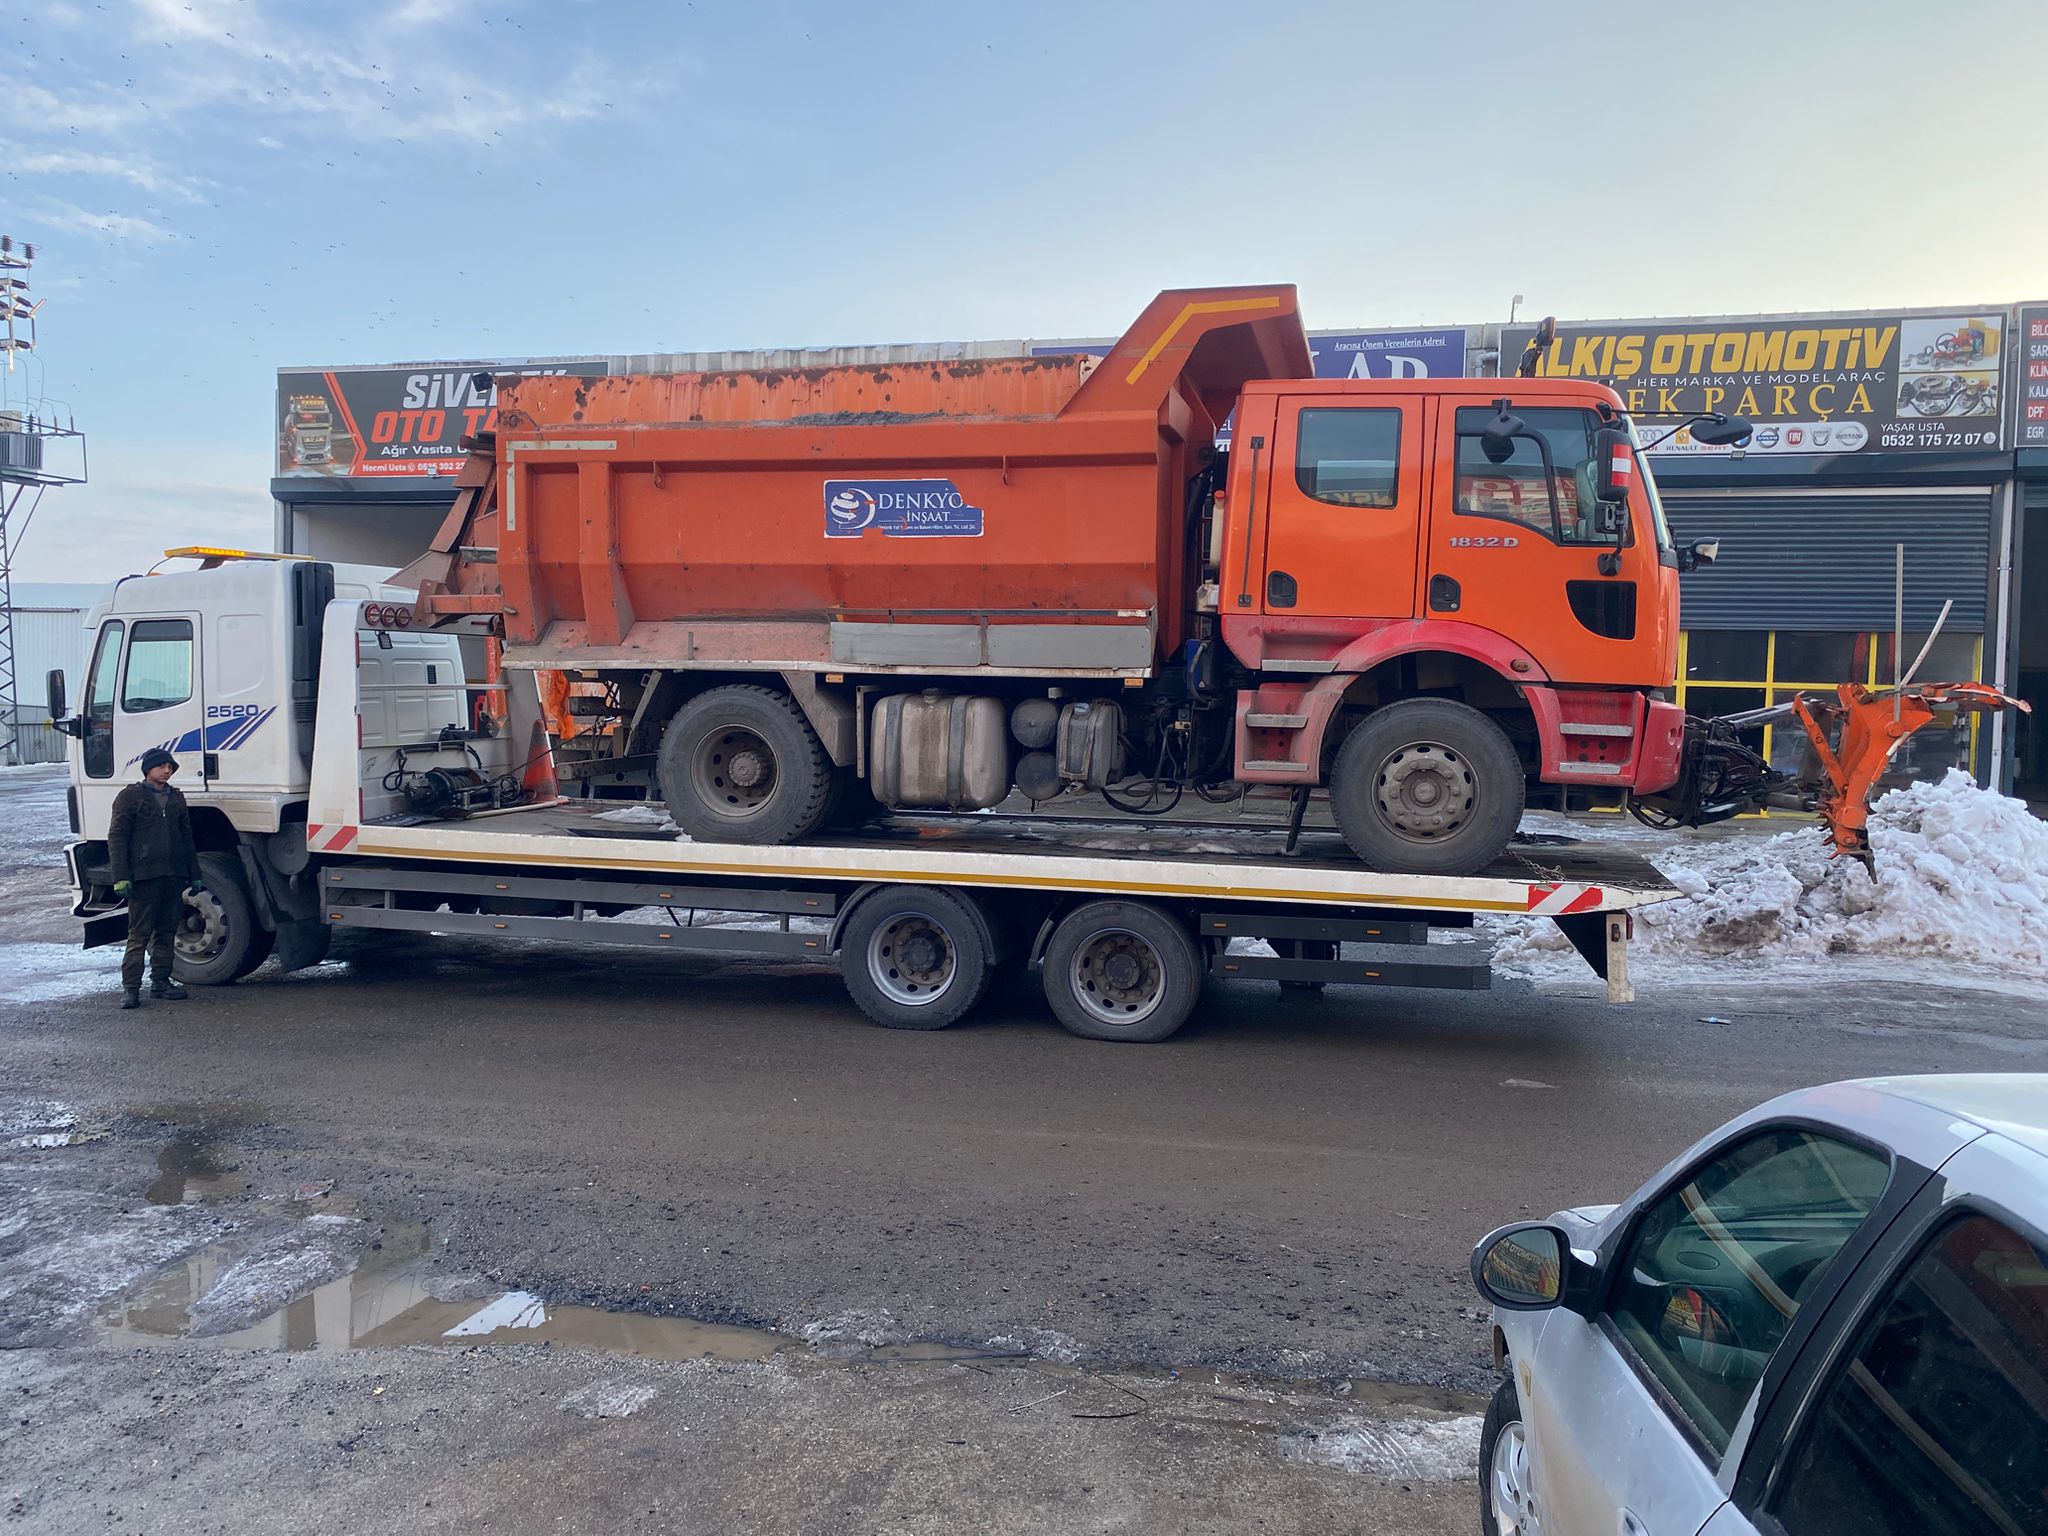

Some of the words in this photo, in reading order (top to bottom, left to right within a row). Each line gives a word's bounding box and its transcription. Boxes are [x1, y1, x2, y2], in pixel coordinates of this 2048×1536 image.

[1334, 341, 1360, 351] Aracına
[1362, 339, 1383, 349] Önem
[1384, 338, 1420, 348] Verenlerin
[1422, 336, 1446, 346] Adresi
[1637, 378, 1668, 387] HER
[1674, 376, 1735, 386] MARKA
[1742, 376, 1760, 384] VE
[1768, 374, 1830, 384] MODEL
[1836, 371, 1886, 383] ARAÇ
[2028, 386, 2048, 398] KAL
[1626, 388, 1684, 417] EK
[1702, 384, 1874, 423] PARÇA
[2028, 406, 2045, 418] DPF
[371, 410, 446, 443] OTO
[1881, 424, 1915, 433] YAŞAR
[1918, 423, 1945, 431] USTA
[2026, 426, 2045, 439] EGR
[1789, 432, 1801, 441] FIAT
[1881, 435, 1914, 446] 0532
[1918, 434, 1942, 446] 175
[1945, 434, 1962, 445] 72
[1965, 433, 1981, 445] 07
[381, 445, 408, 457] Ağır
[412, 445, 452, 454] Vasıta
[362, 464, 387, 472] Necmi
[388, 463, 407, 471] Usta
[906, 510, 950, 524] İNŞAAT
[1450, 537, 1500, 548] 1832
[1503, 537, 1519, 548] D
[207, 704, 259, 718] 2520
